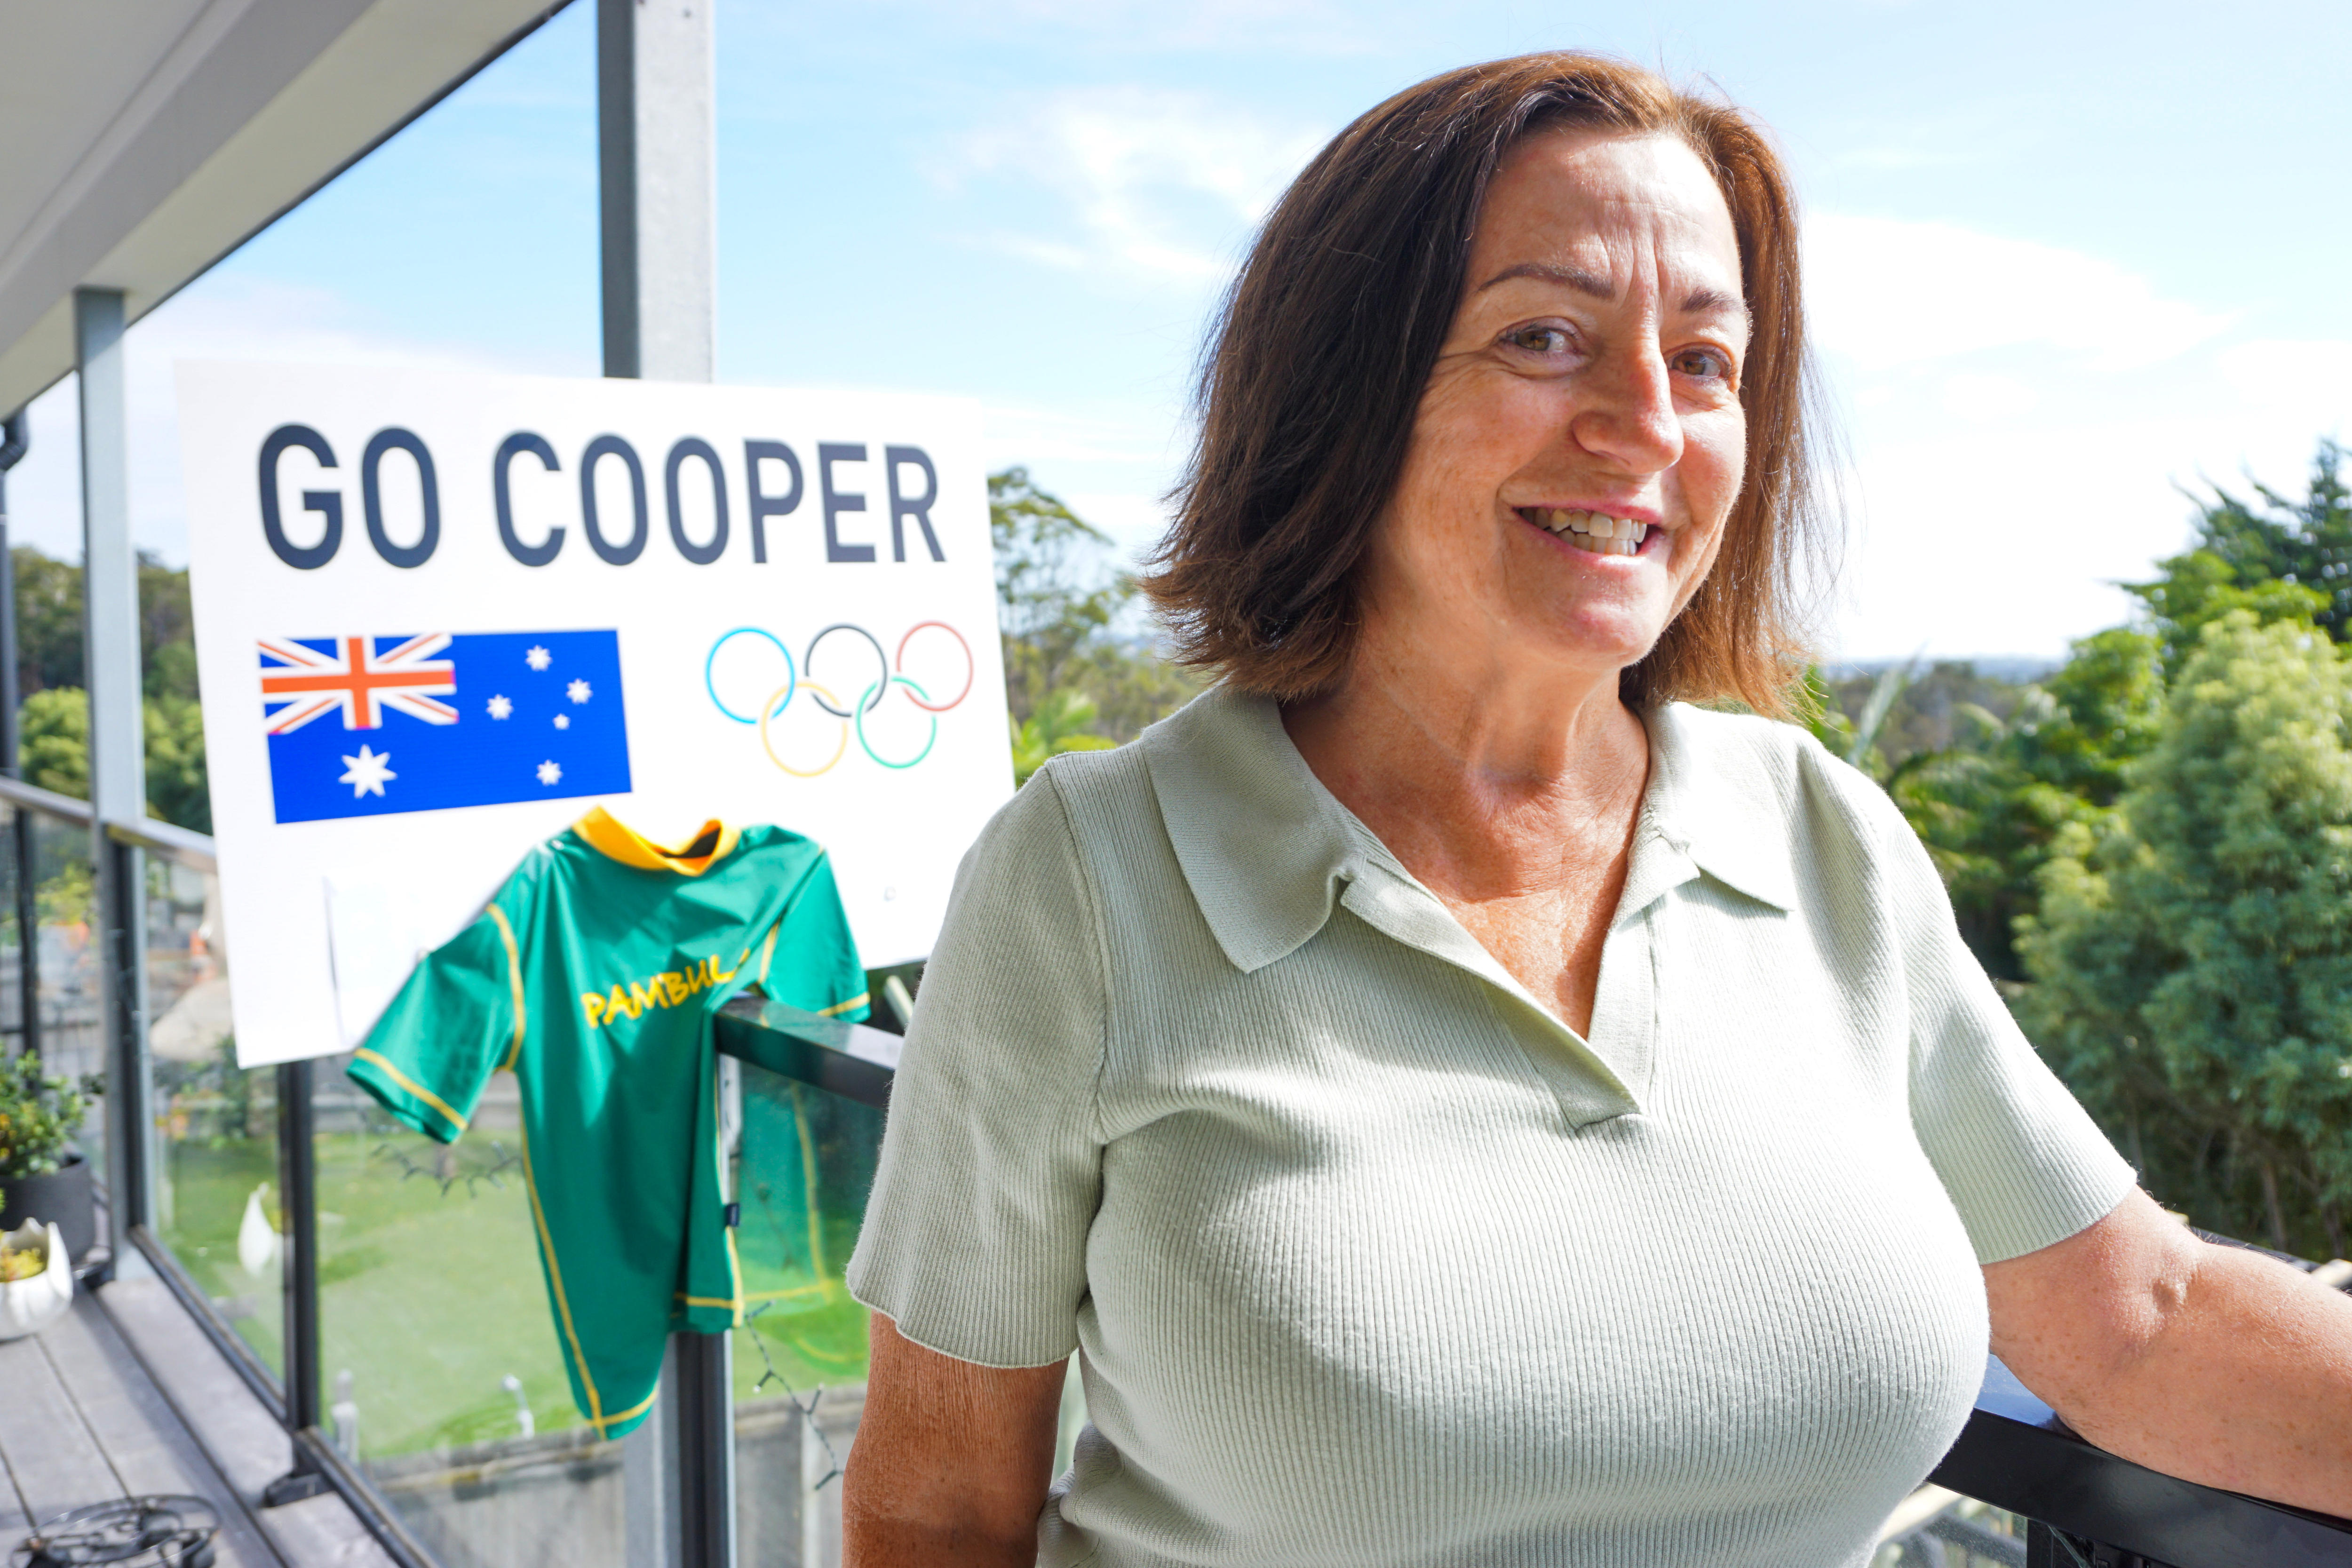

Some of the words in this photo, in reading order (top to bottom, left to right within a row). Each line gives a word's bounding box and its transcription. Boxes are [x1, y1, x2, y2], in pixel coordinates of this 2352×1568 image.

[258, 423, 440, 570] GO
[493, 431, 945, 567] COOPER
[580, 947, 750, 1029] PAMBUL
